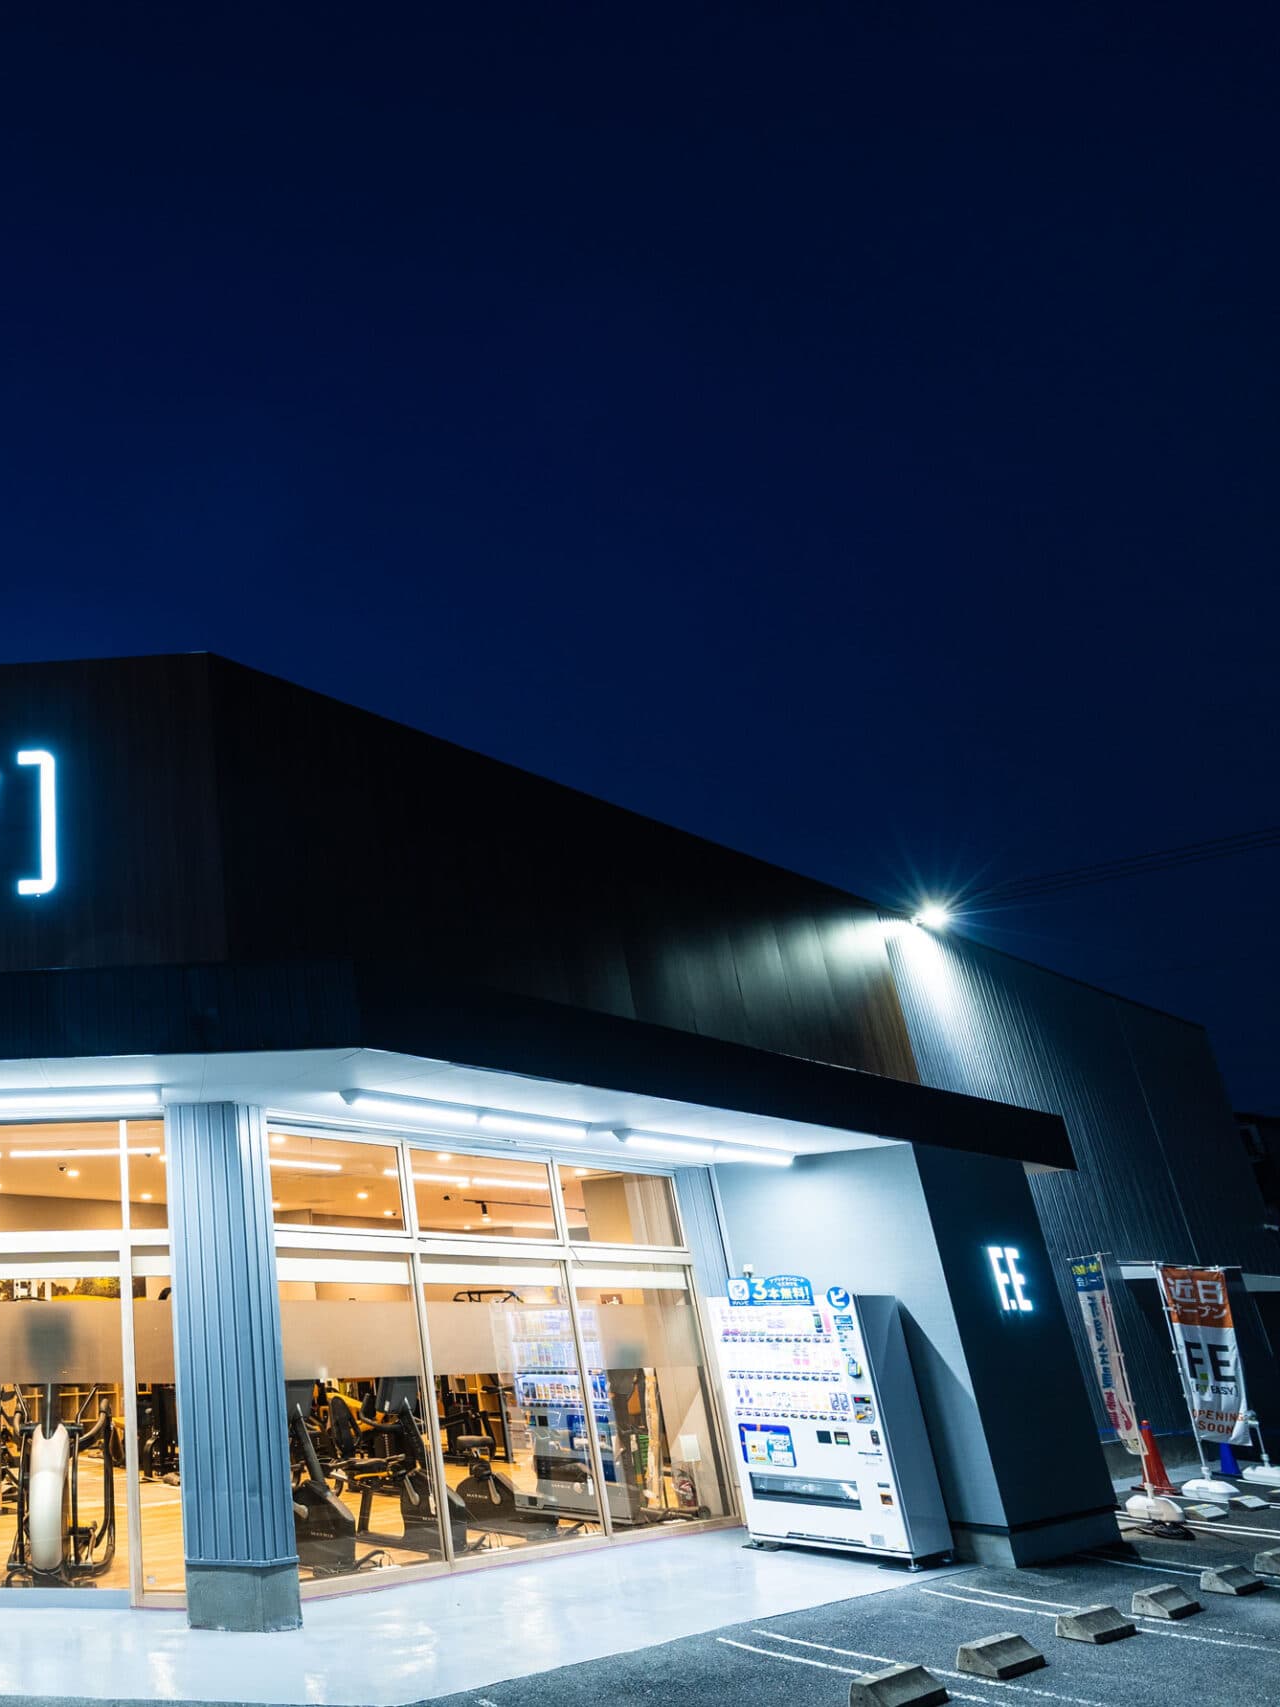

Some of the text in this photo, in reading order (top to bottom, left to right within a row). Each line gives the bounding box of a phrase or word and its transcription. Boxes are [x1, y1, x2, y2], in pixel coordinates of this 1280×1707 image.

[1167, 1277, 1225, 1305] 近日
[1192, 1408, 1245, 1422] OPENING
[1199, 1419, 1234, 1434] SOON
